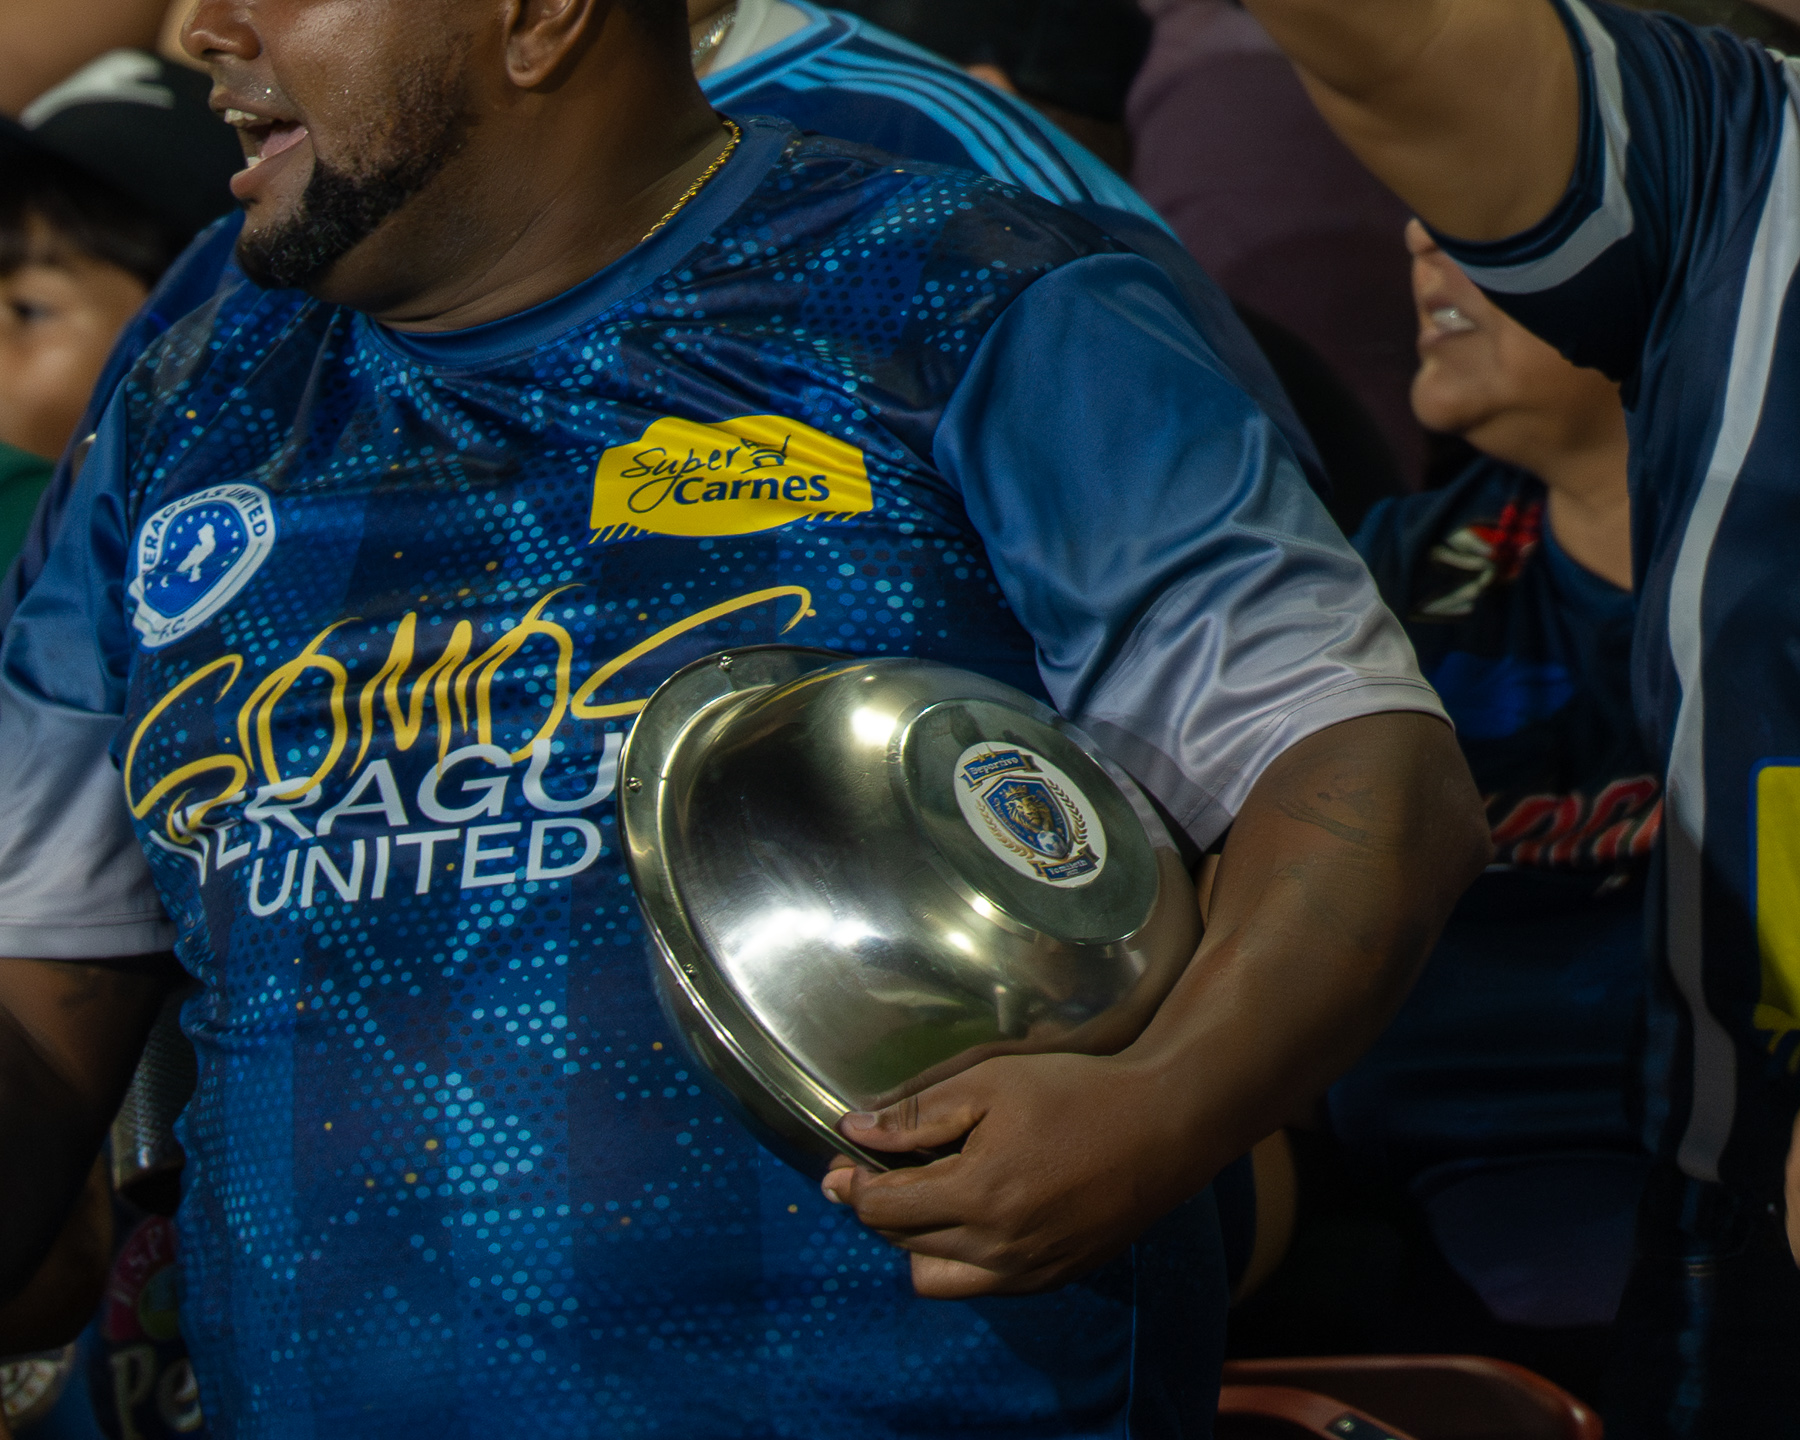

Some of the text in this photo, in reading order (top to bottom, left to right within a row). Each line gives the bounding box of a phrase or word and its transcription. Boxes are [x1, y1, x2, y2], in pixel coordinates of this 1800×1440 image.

[620, 446, 741, 514] Super
[673, 474, 831, 505] Carnes
[142, 487, 269, 567] ERAGUAS UNITED
[148, 732, 623, 887] VERAGU
[246, 817, 603, 917] UNITED
